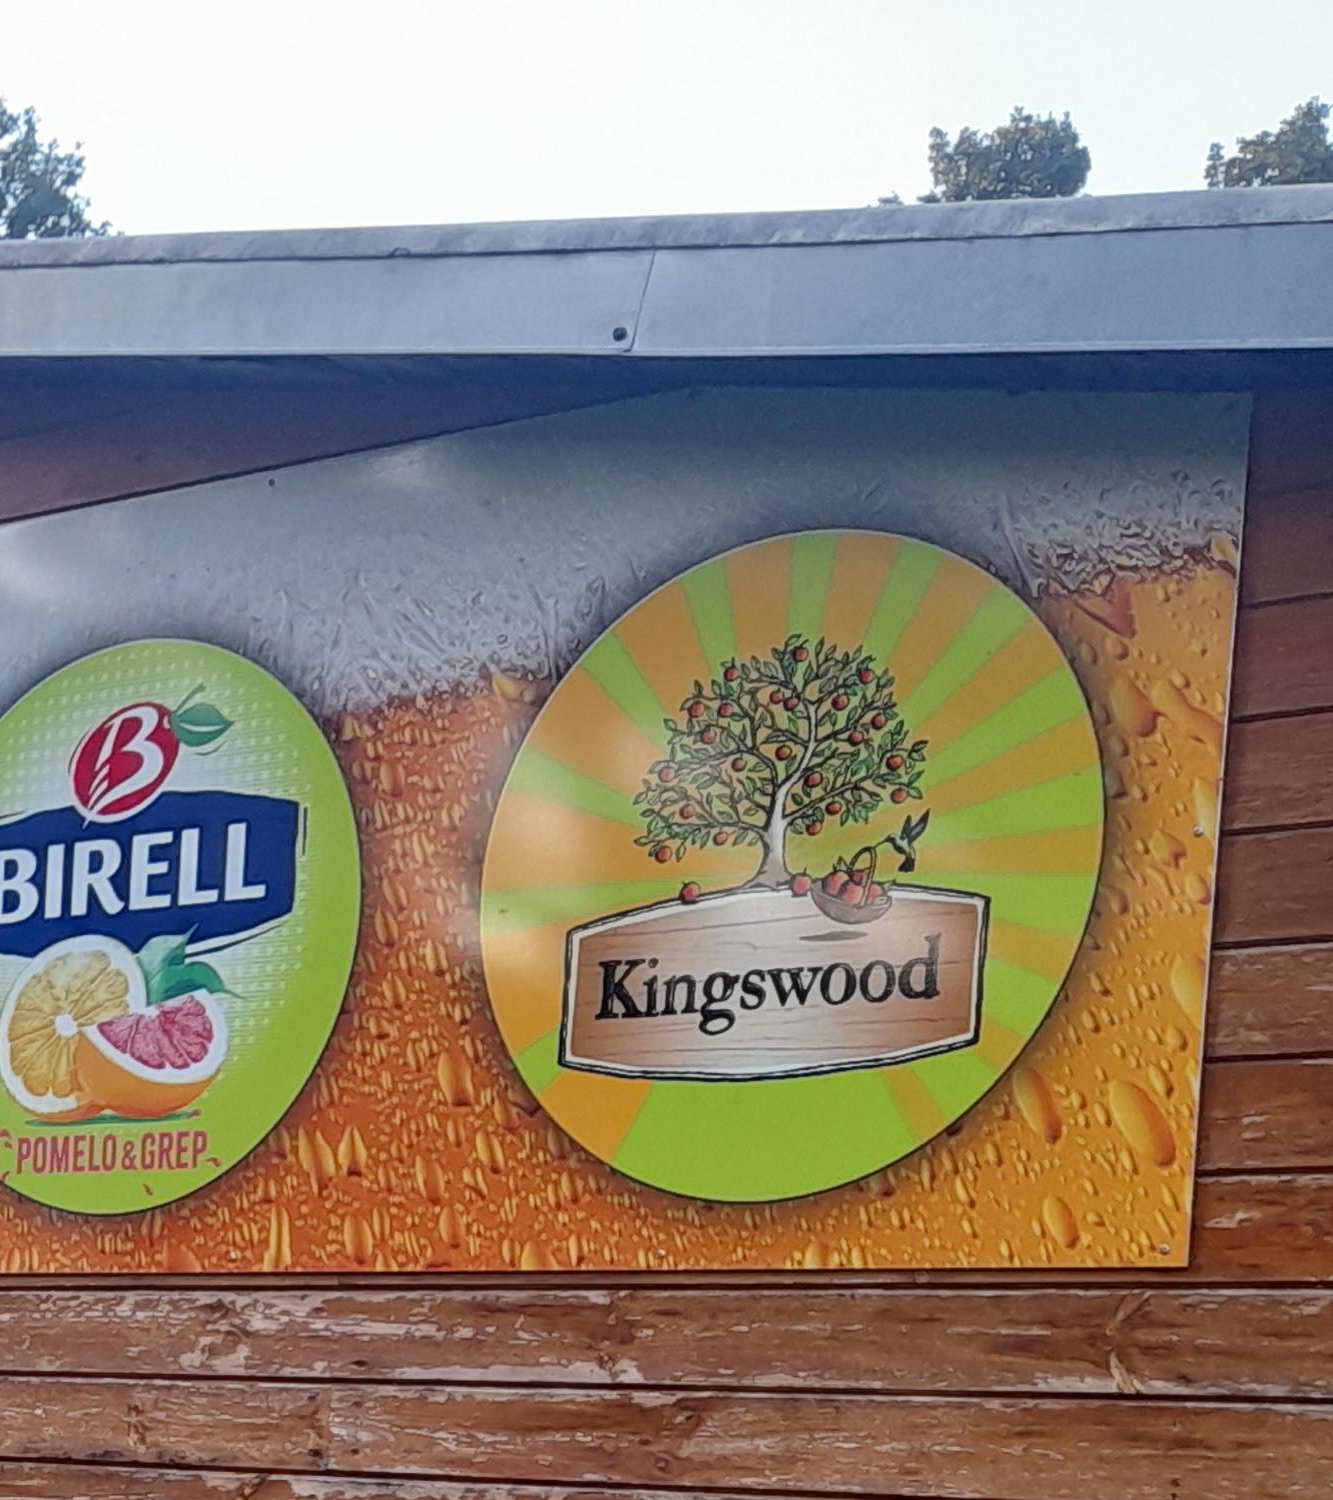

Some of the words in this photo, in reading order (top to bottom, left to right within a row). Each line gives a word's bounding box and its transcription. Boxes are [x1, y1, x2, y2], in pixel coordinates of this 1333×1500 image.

[594, 934, 942, 1036] Kingswood
[16, 1132, 118, 1175] POMELO
[121, 1139, 138, 1171] &
[140, 1129, 209, 1171] GREP
